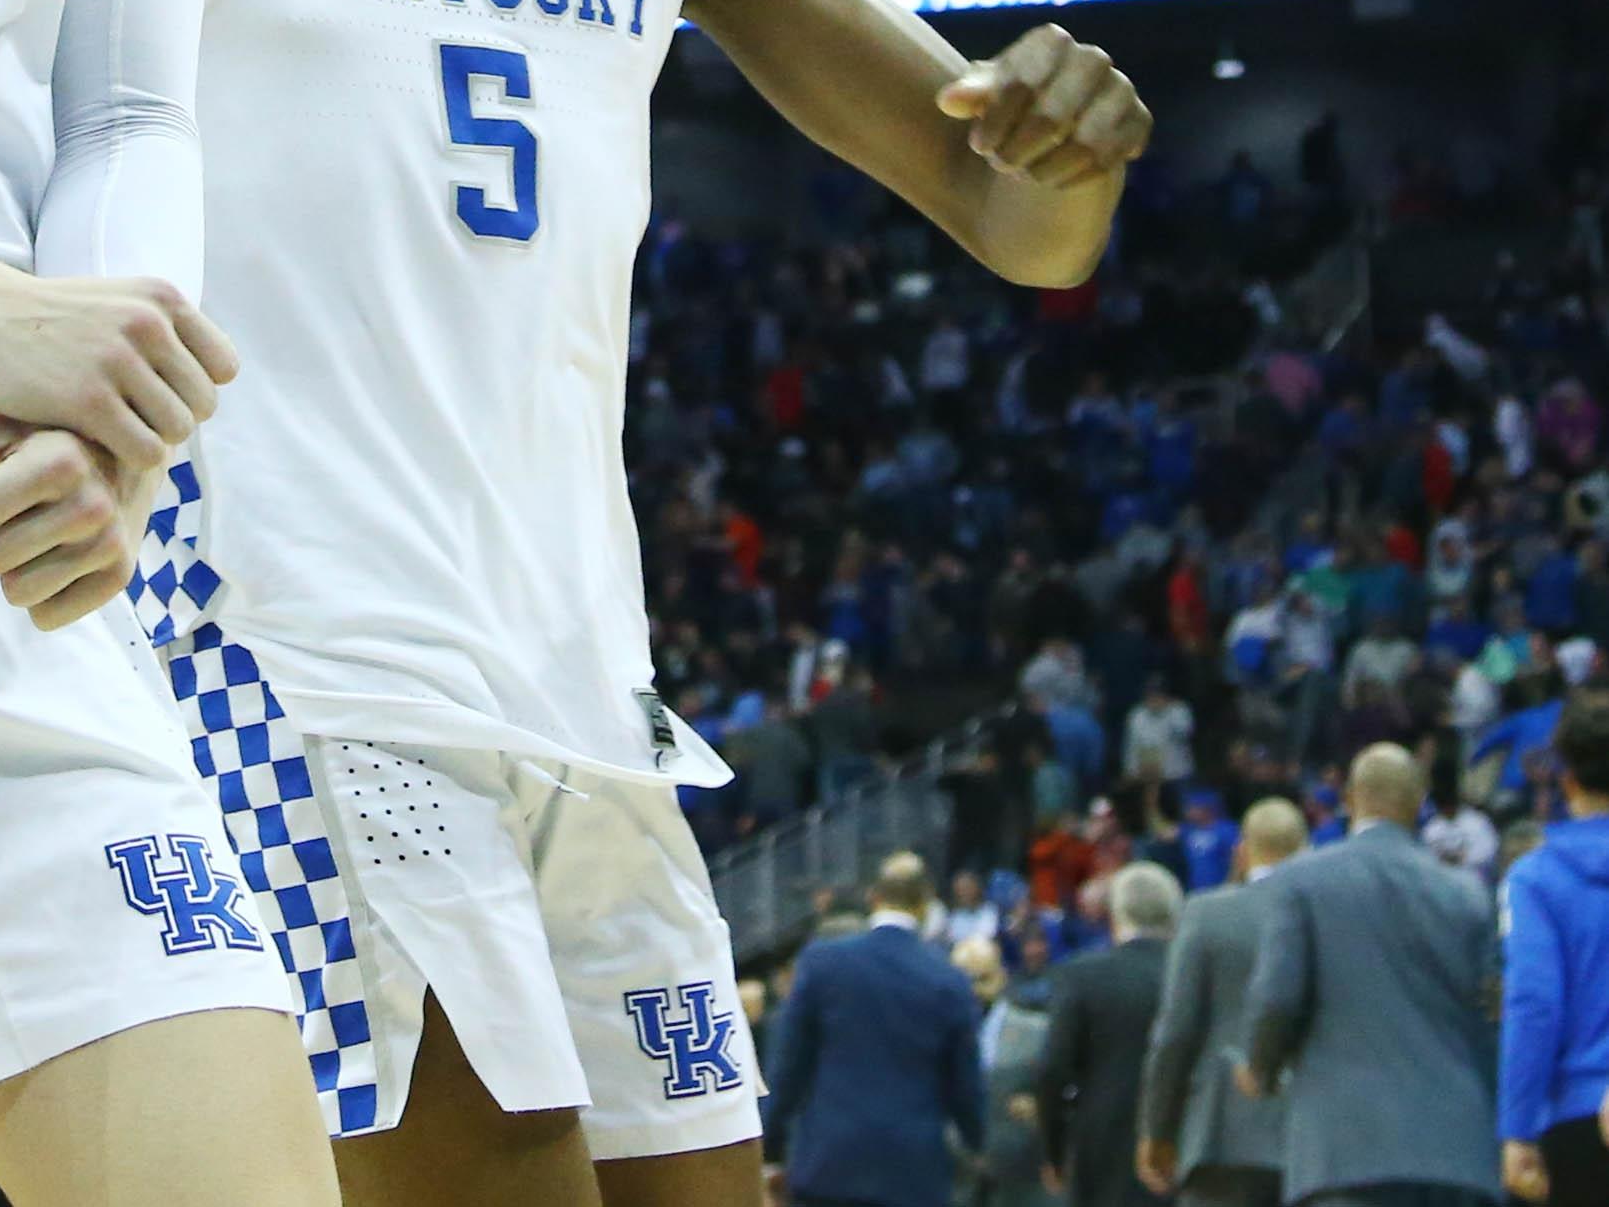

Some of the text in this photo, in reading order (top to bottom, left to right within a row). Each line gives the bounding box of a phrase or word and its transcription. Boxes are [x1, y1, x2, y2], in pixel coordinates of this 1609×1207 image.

[436, 40, 541, 244] 5
[104, 834, 264, 956] UK
[624, 980, 743, 1100] UK
